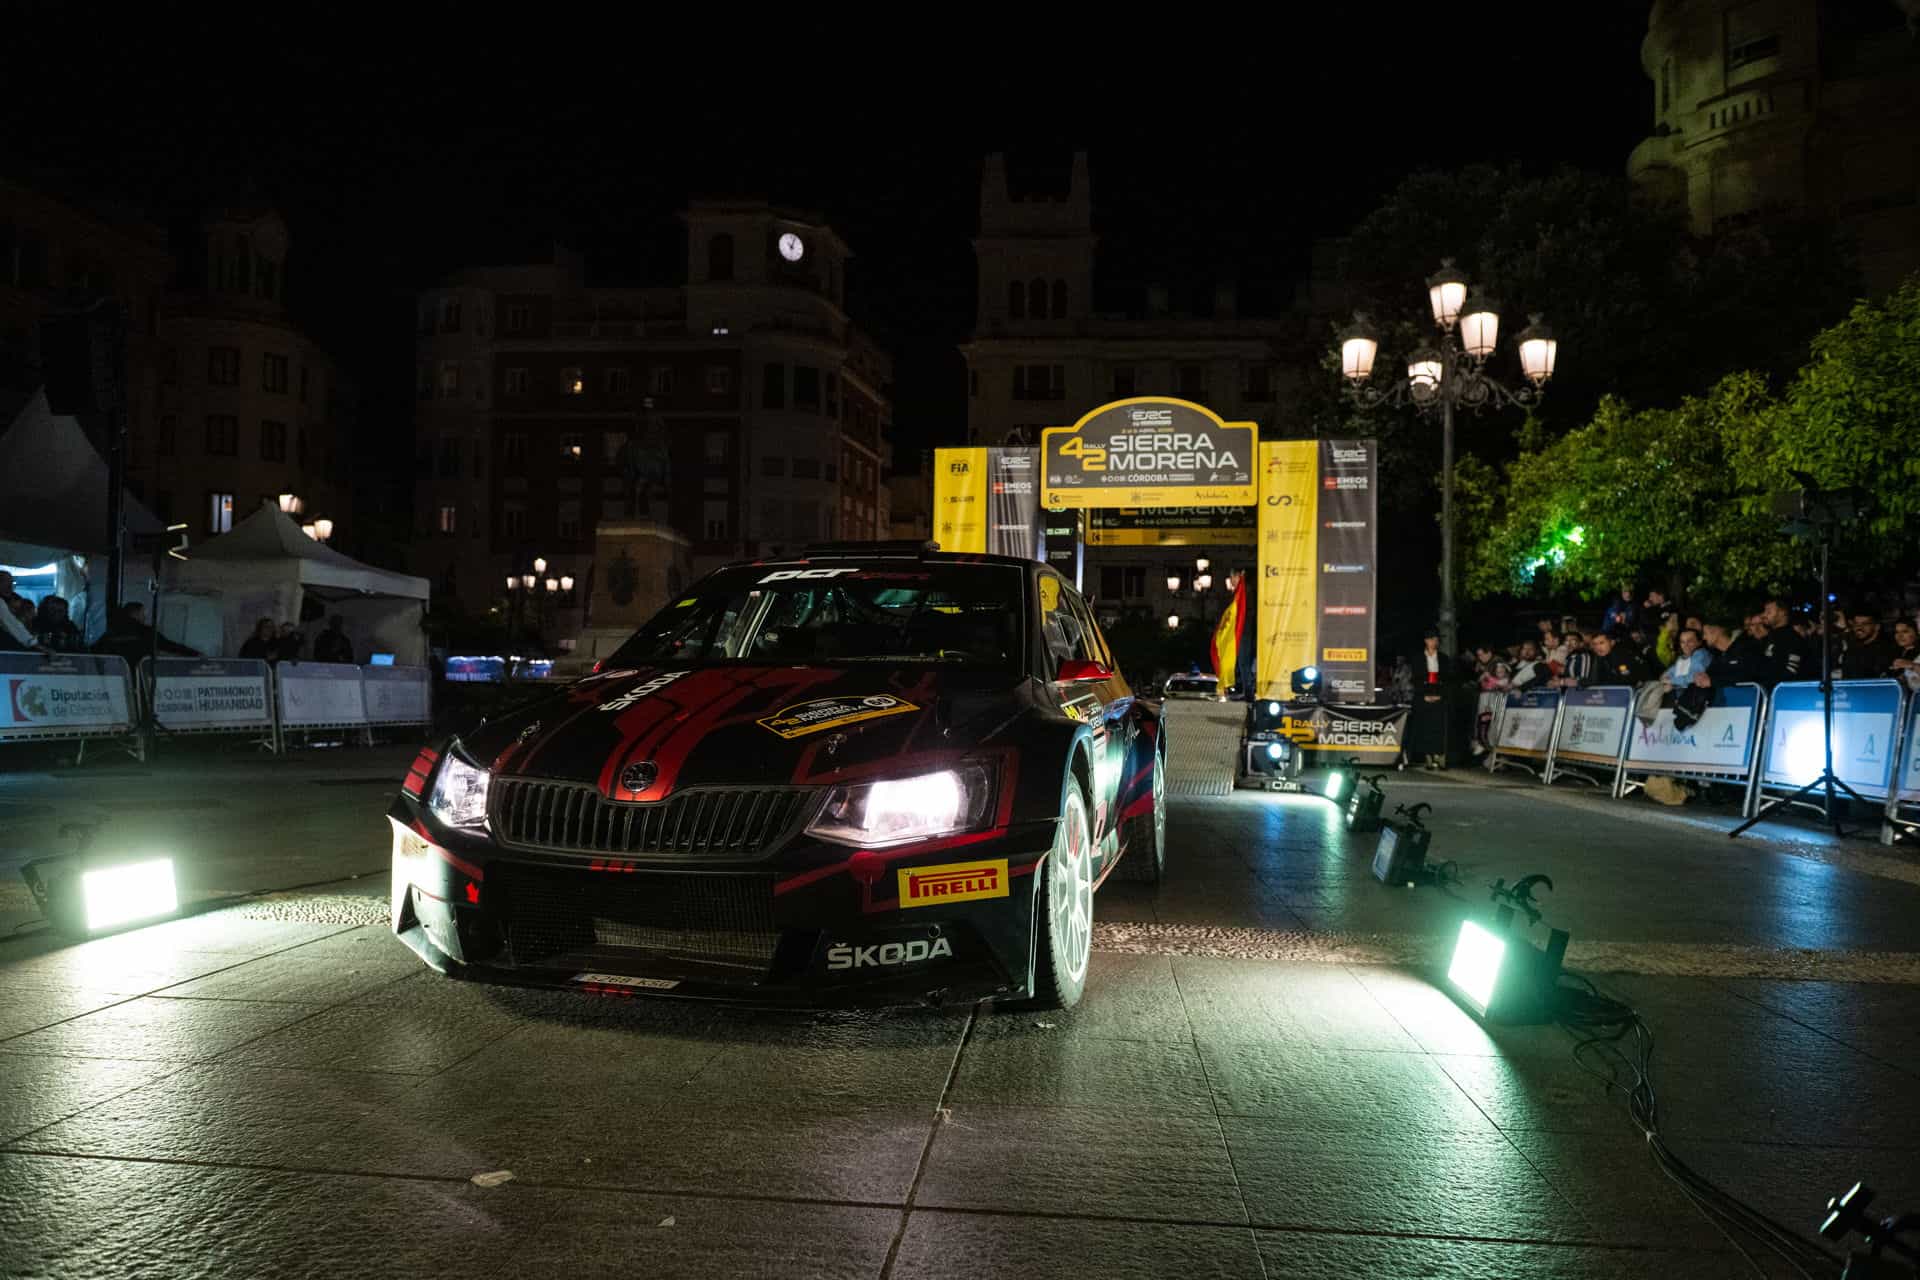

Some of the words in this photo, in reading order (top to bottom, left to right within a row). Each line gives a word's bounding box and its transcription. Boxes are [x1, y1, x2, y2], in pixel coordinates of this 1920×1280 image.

[1059, 436, 1107, 471] 42
[1109, 433, 1214, 452] SIERRA
[1109, 451, 1239, 471] MORENA
[597, 670, 694, 711] ŠKODA
[1292, 719, 1329, 729] RALLY
[1332, 720, 1397, 733] SIERRA
[1318, 733, 1397, 745] MORENA
[909, 867, 998, 899] PIRELLI
[827, 937, 953, 970] ŠKODA
